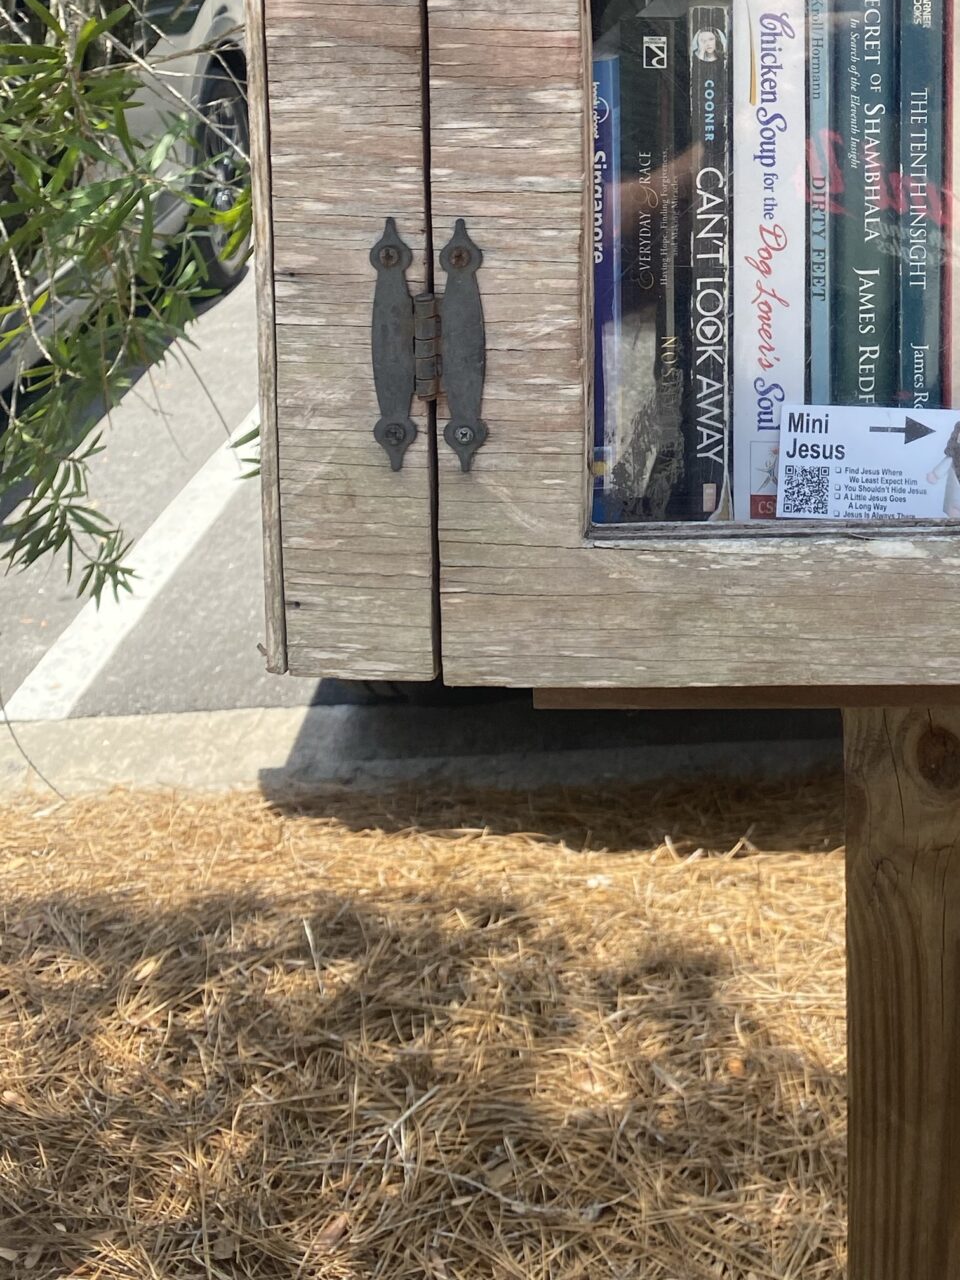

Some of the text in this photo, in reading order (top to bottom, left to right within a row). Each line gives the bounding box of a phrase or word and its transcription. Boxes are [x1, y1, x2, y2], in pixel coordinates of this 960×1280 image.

[759, 12, 796, 105] Chicken
[869, 69, 881, 94] OF
[704, 80, 714, 142] COONER
[848, 19, 861, 169] In Search of the Eleventh Insight
[910, 88, 928, 124] THE
[753, 106, 787, 167] Soup
[763, 173, 779, 191] for
[863, 103, 886, 242] SHAMBHALA
[909, 131, 928, 197] TENTH
[660, 199, 670, 230] Finding
[764, 195, 778, 220] the
[745, 224, 788, 278] Dog
[810, 177, 826, 302] DIRTY FEET
[908, 206, 928, 290] INSIGHT
[695, 277, 725, 366] LOOK
[853, 267, 880, 335] JAMES
[910, 343, 929, 388] James
[695, 375, 724, 464] AWAY
[754, 377, 785, 432] Soul
[788, 413, 829, 434] Mini
[785, 438, 846, 460] Jesus
[844, 467, 860, 475] Find
[868, 494, 888, 502] Jesus
[881, 477, 903, 486] Expect
[891, 486, 906, 494] Hide
[908, 487, 927, 495] Jesus
[855, 502, 872, 511] Long
[873, 503, 887, 512] Way
